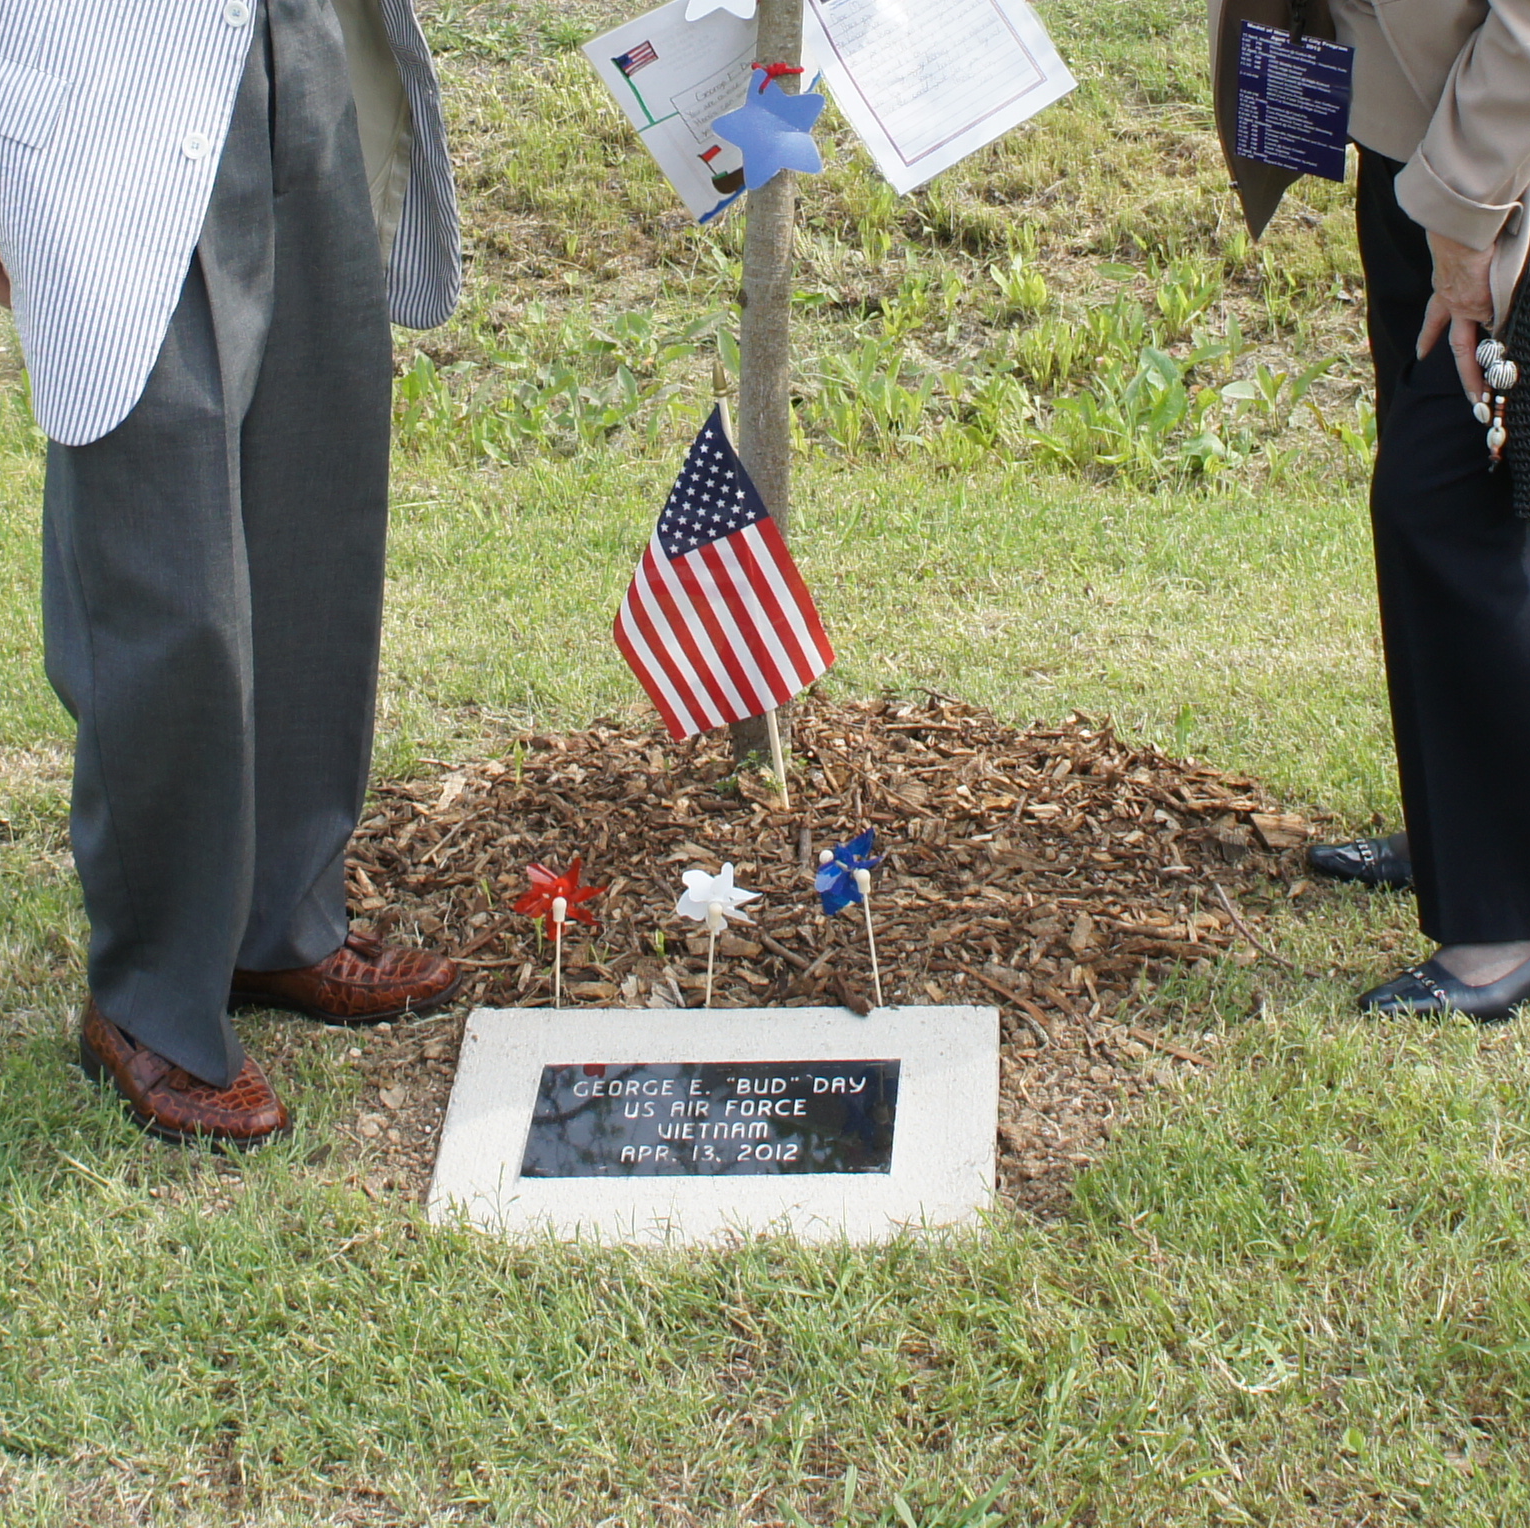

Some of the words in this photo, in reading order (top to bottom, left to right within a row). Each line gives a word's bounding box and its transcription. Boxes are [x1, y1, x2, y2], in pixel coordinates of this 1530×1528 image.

[573, 1079, 675, 1098] GEORGE
[689, 1078, 711, 1097] E.
[726, 1076, 800, 1095] "BUD"
[813, 1076, 867, 1095] DAY
[624, 1101, 655, 1119] US
[670, 1100, 710, 1118] AIR
[725, 1098, 807, 1117] FORCE
[658, 1121, 768, 1140] VIETNAM
[620, 1144, 678, 1163] APR.
[737, 1143, 799, 1162] 2012
